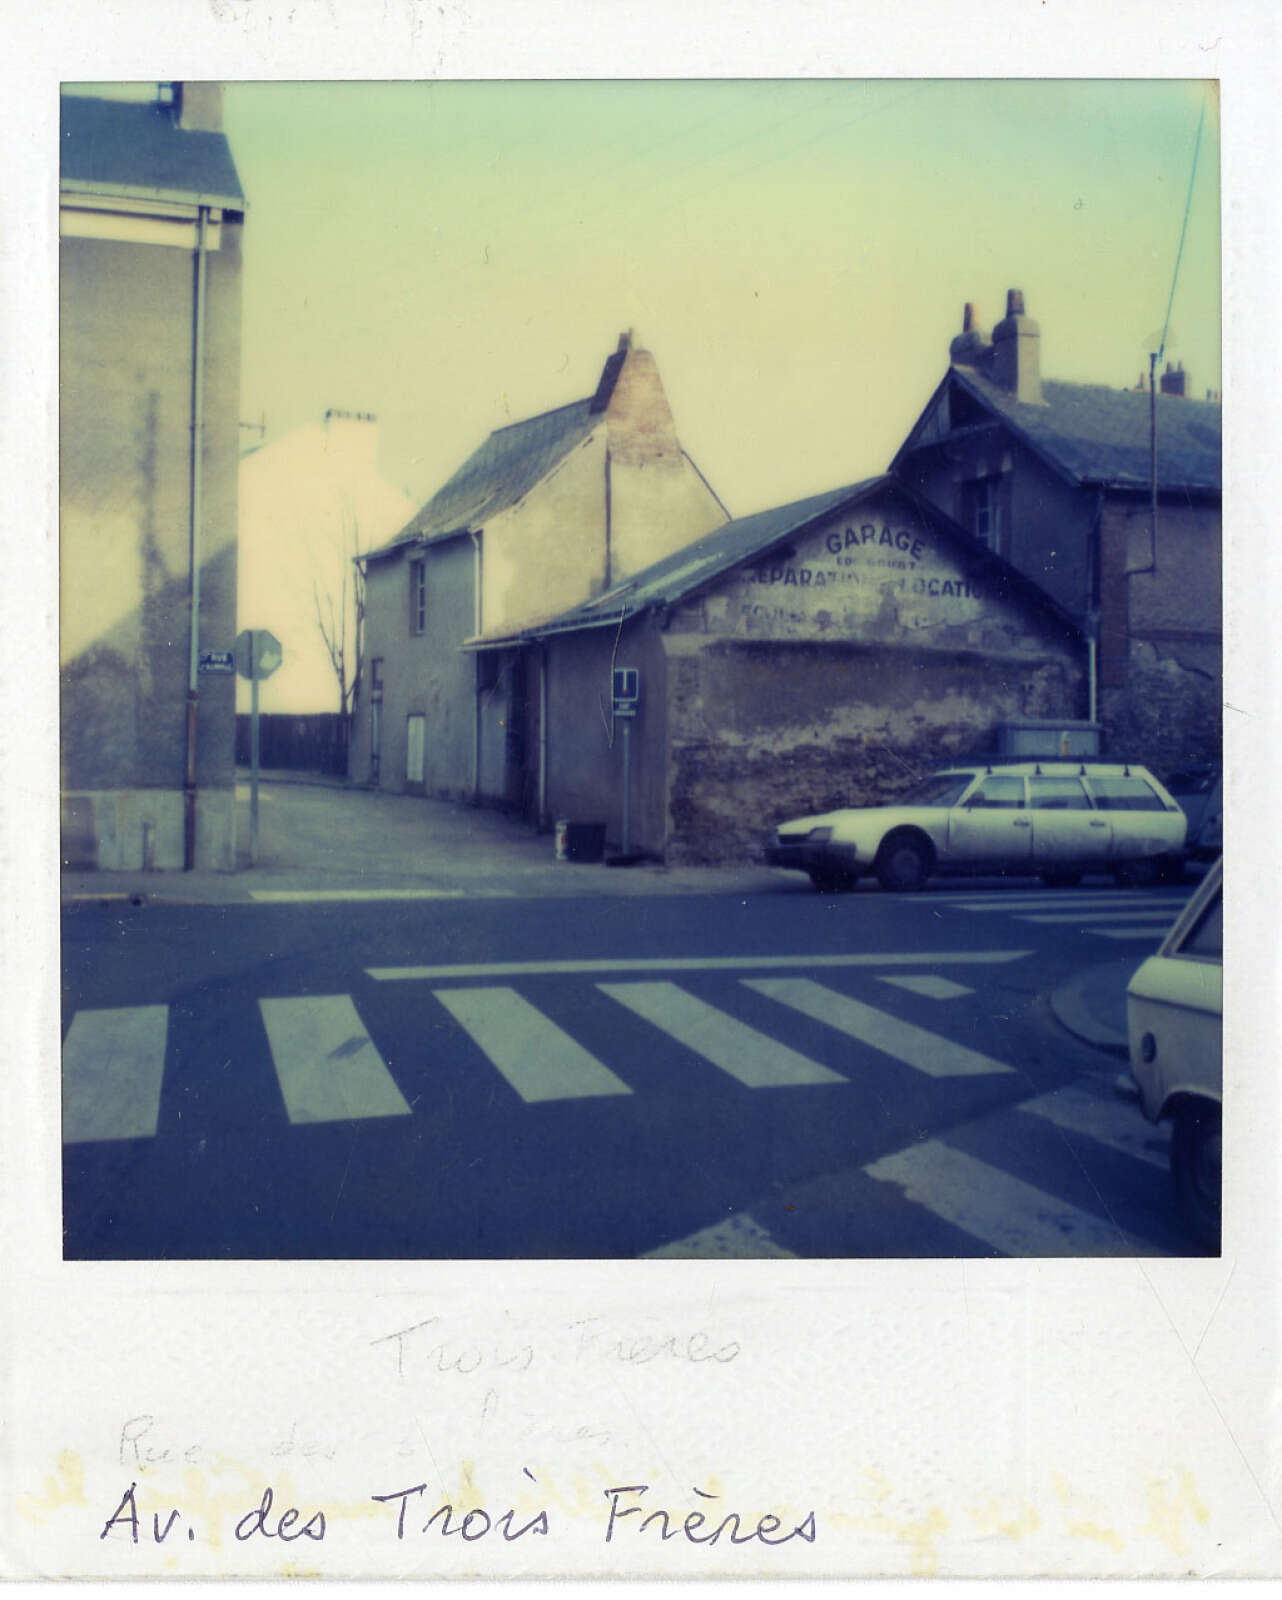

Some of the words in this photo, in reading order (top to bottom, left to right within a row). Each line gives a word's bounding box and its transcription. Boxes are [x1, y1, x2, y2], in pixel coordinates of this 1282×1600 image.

[825, 523, 927, 562] GARAGE
[100, 1481, 196, 1545] Av.
[234, 1486, 327, 1543] des
[371, 1466, 550, 1543] Trois
[603, 1485, 817, 1546] Frères
